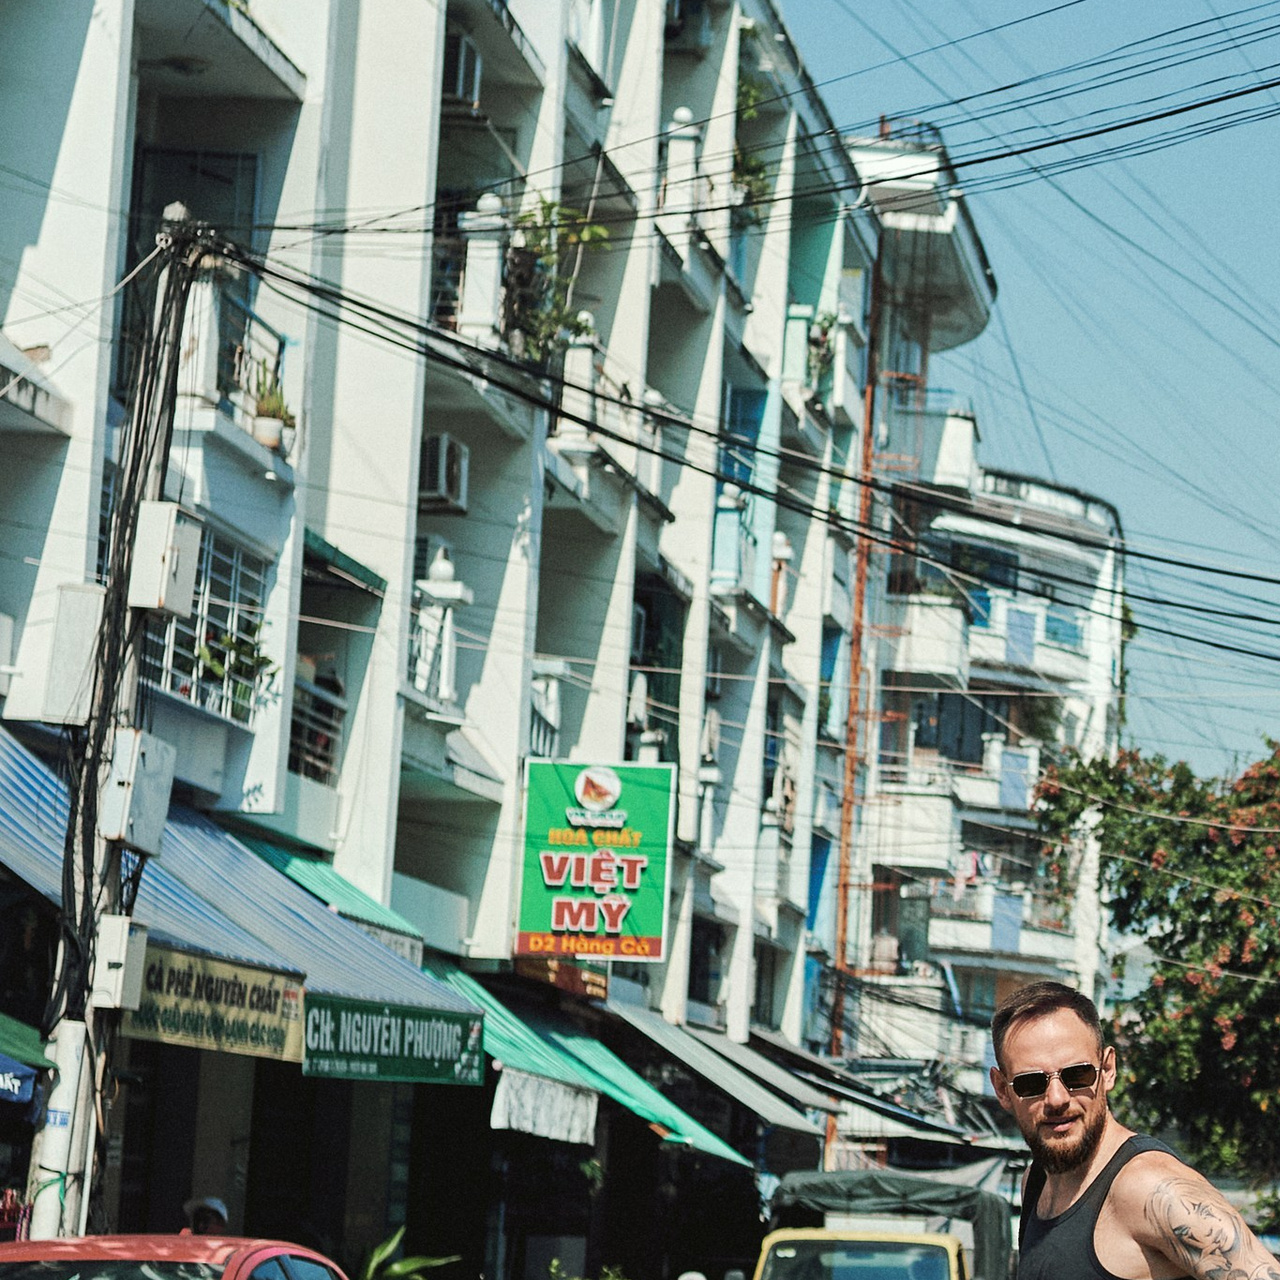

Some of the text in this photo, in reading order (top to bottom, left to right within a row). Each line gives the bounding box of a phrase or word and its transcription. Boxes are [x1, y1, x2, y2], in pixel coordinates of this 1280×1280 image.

[592, 826, 642, 848] CHẤT
[540, 849, 648, 894] VIỆT
[552, 894, 631, 933] MỸ
[529, 934, 556, 952] D2
[561, 933, 616, 956] Hàng
